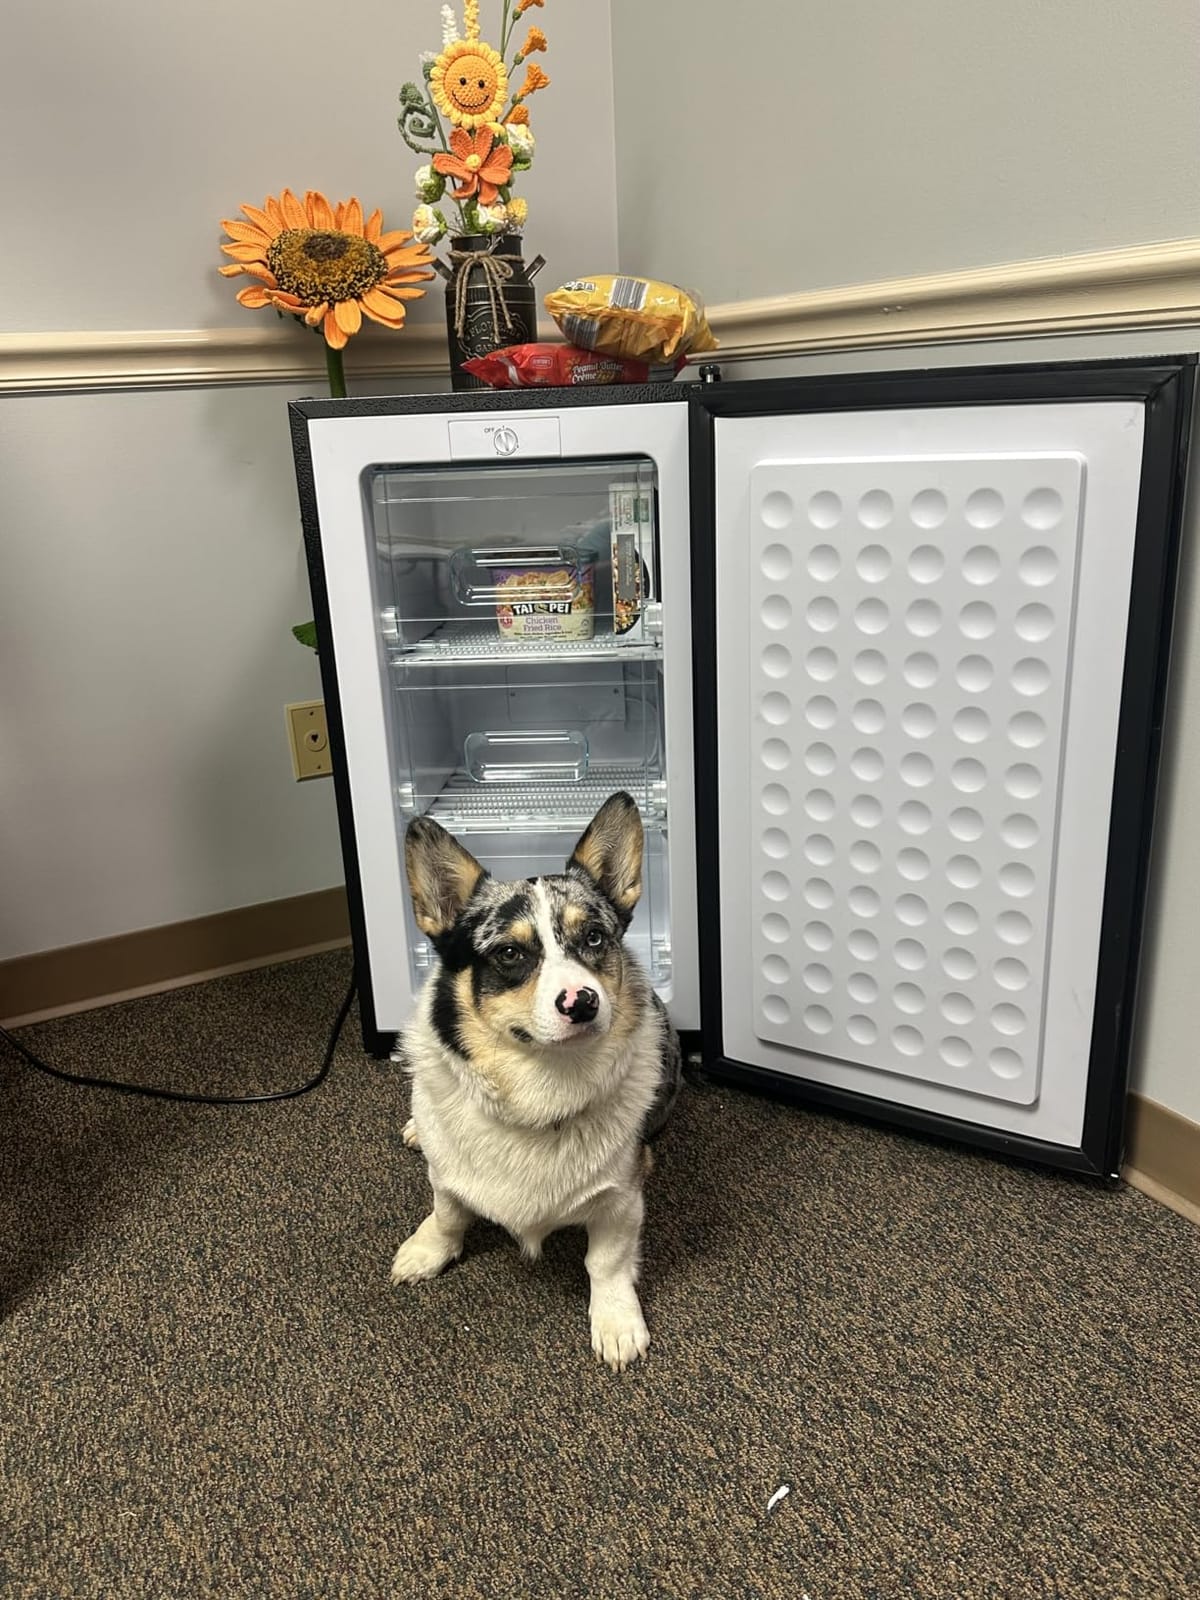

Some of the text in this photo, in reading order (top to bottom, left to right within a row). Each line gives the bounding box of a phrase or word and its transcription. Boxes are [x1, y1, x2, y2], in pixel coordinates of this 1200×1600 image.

[513, 603, 569, 615] TAI PEI
[525, 615, 559, 625] Chicken
[523, 623, 562, 632] Fried Rice
